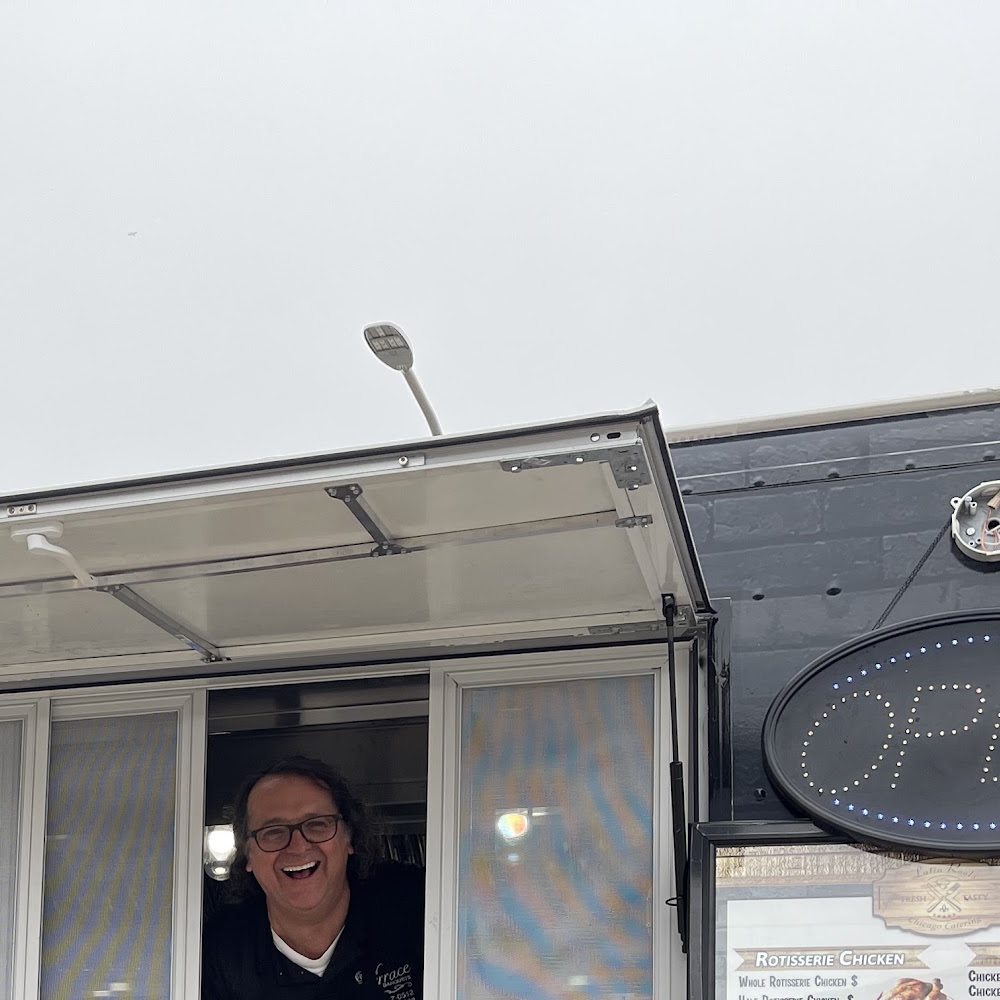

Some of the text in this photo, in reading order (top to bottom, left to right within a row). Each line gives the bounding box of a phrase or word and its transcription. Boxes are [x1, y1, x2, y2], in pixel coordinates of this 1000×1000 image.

[900, 895, 927, 903] FRESH
[963, 894, 988, 902] TASTY
[908, 917, 982, 930] Chicago Catering
[755, 950, 905, 967] ROTISSERIE CHICKEN
[739, 975, 858, 987] WHOLE ROTISSERIE CHICKEN $
